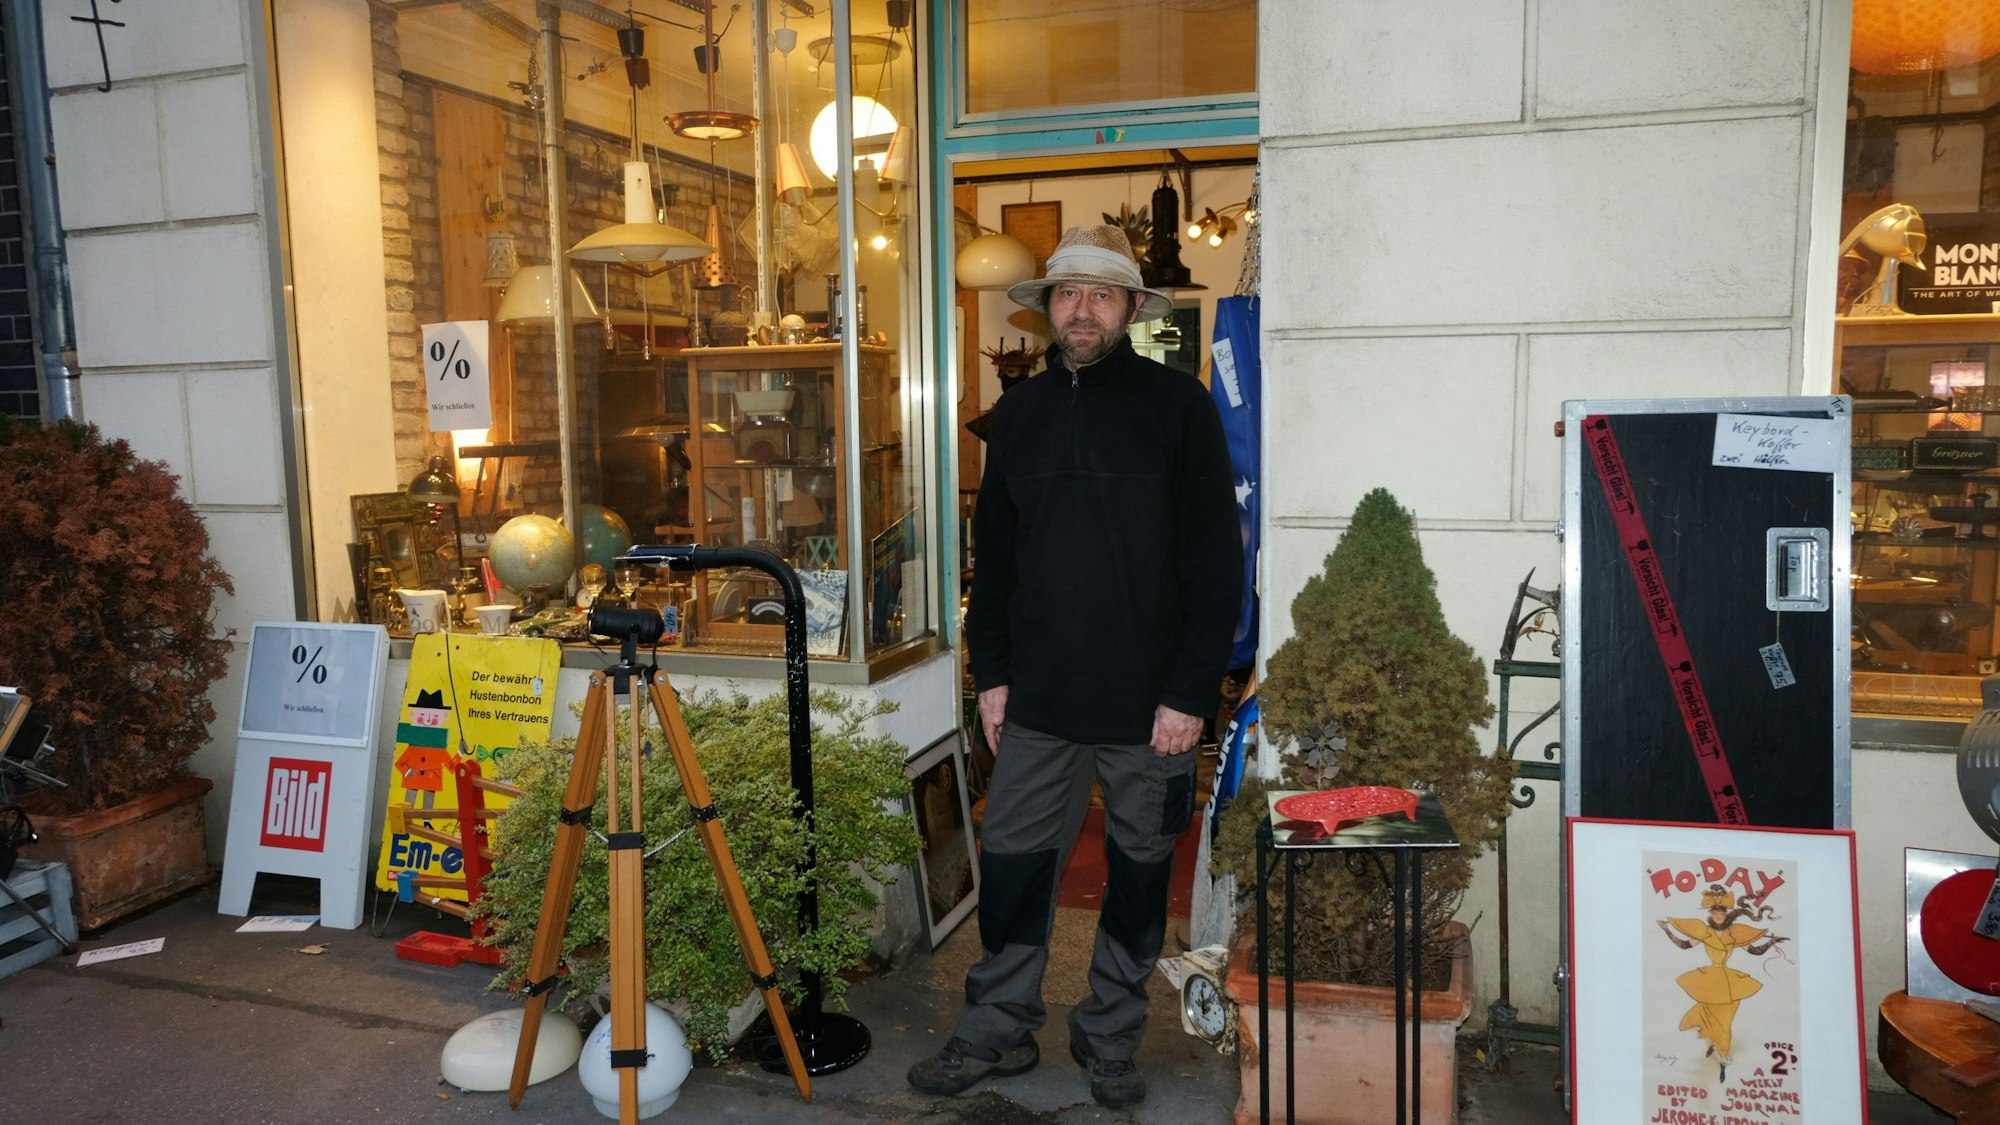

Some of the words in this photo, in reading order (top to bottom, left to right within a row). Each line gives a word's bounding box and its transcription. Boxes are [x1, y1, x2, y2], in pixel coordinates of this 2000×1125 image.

[1096, 127, 1126, 145] ART
[1934, 265, 2000, 286] BLAN
[1913, 291, 1934, 299] THE
[1940, 290, 1960, 298] ART
[1966, 290, 1980, 298] OF
[432, 403, 444, 411] Wir
[446, 402, 476, 411] schließen
[1757, 438, 1801, 454] Koffer
[1931, 447, 1983, 460] Gritzner
[1596, 435, 1617, 476] Vorsicht
[1609, 476, 1628, 502] Glas!
[1787, 555, 1801, 573] Top
[1638, 556, 1660, 597] Vorsicht
[1652, 597, 1670, 623] Glas!
[472, 671, 491, 682] Der
[493, 673, 544, 685] bewähr
[470, 689, 542, 705] Hustenbonbon
[283, 703, 296, 712] Wir
[296, 704, 325, 713] schließen
[468, 707, 491, 719] Ihres
[494, 710, 549, 724] Vertrauens
[1680, 679, 1702, 719] Vorsicht
[1694, 719, 1713, 744] Glas!
[266, 768, 326, 839] Bild
[1764, 1041, 1795, 1052] PRICE
[1754, 1067, 1764, 1076] A
[1657, 1084, 1708, 1099] EDITED
[1740, 1078, 1784, 1089] WEEKLY
[1671, 1097, 1687, 1107] BY
[1725, 1087, 1801, 1105] MAGAZINE
[1721, 1098, 1801, 1118] JOURNAL
